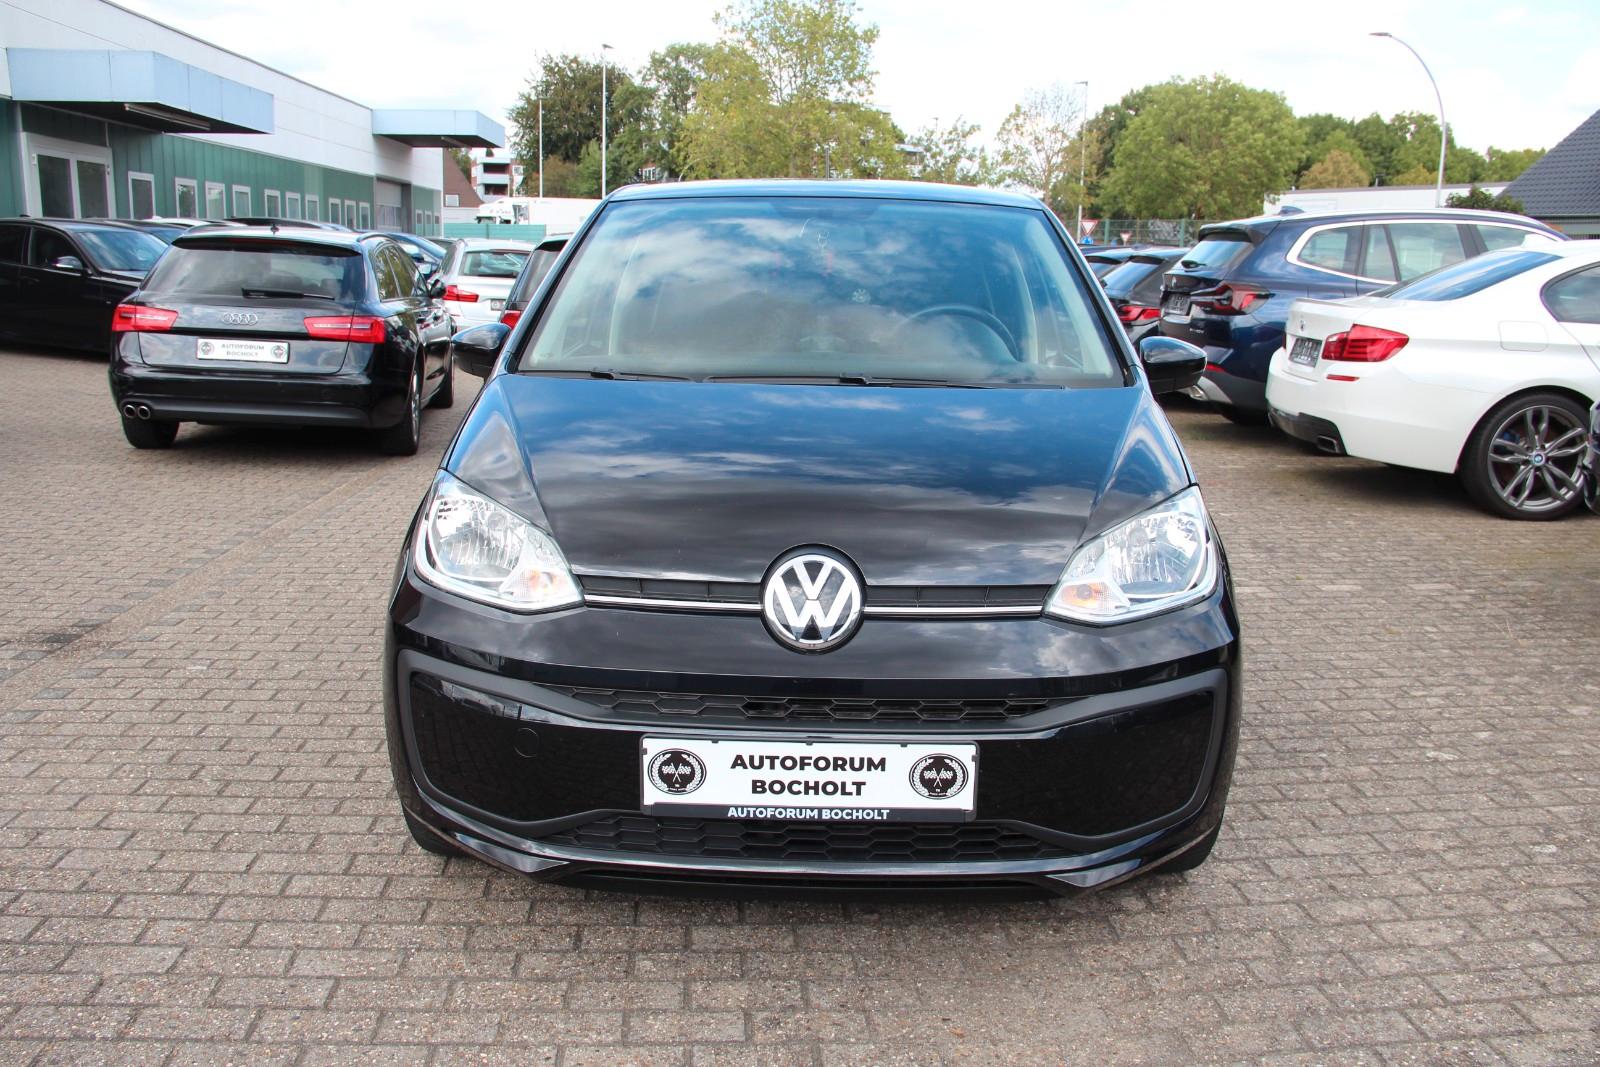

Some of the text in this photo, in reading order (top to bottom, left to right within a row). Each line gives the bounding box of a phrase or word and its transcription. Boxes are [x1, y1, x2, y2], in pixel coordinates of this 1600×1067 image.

[766, 555, 859, 642] VW
[730, 754, 887, 772] AUTOFORUM
[751, 779, 866, 796] BOCHOLT
[727, 806, 890, 821] AUTOFORUM BOCHOLT
